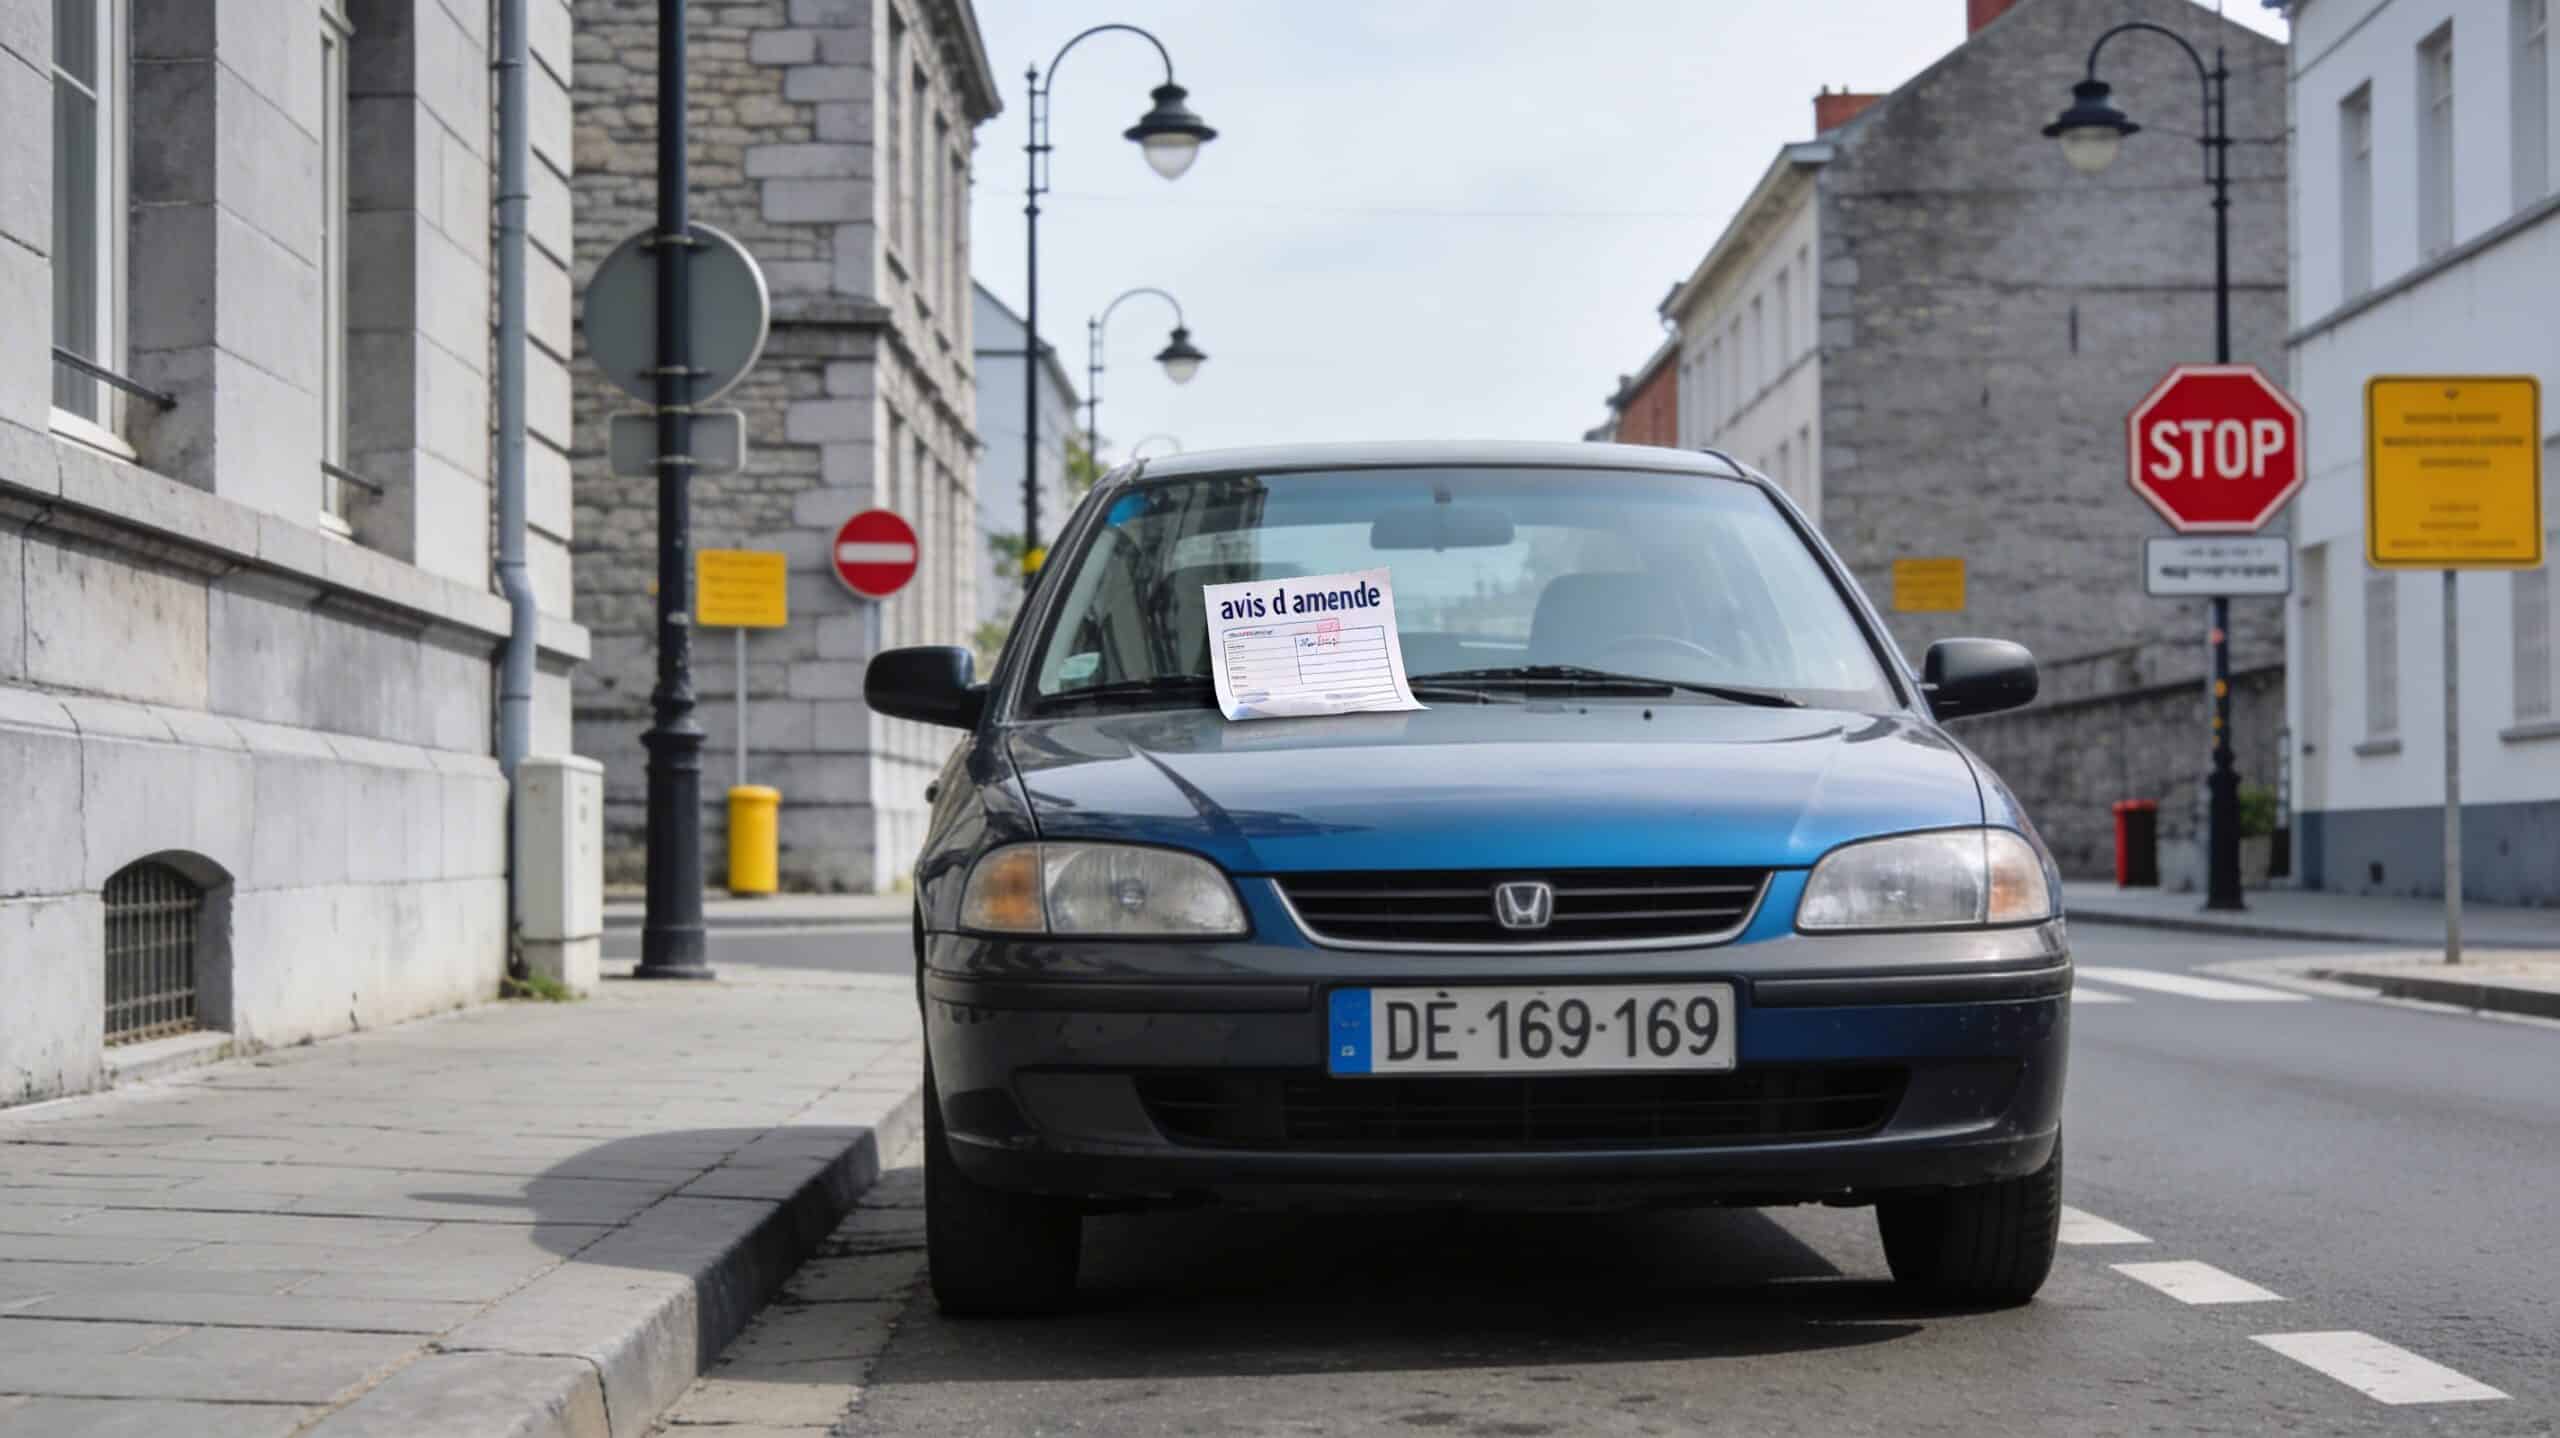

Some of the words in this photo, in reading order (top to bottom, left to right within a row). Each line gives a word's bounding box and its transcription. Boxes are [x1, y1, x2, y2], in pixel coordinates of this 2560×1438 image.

[2149, 418, 2286, 480] STOP
[1221, 592, 1266, 620] avis
[1273, 588, 1287, 615] d
[1292, 581, 1381, 614] amende
